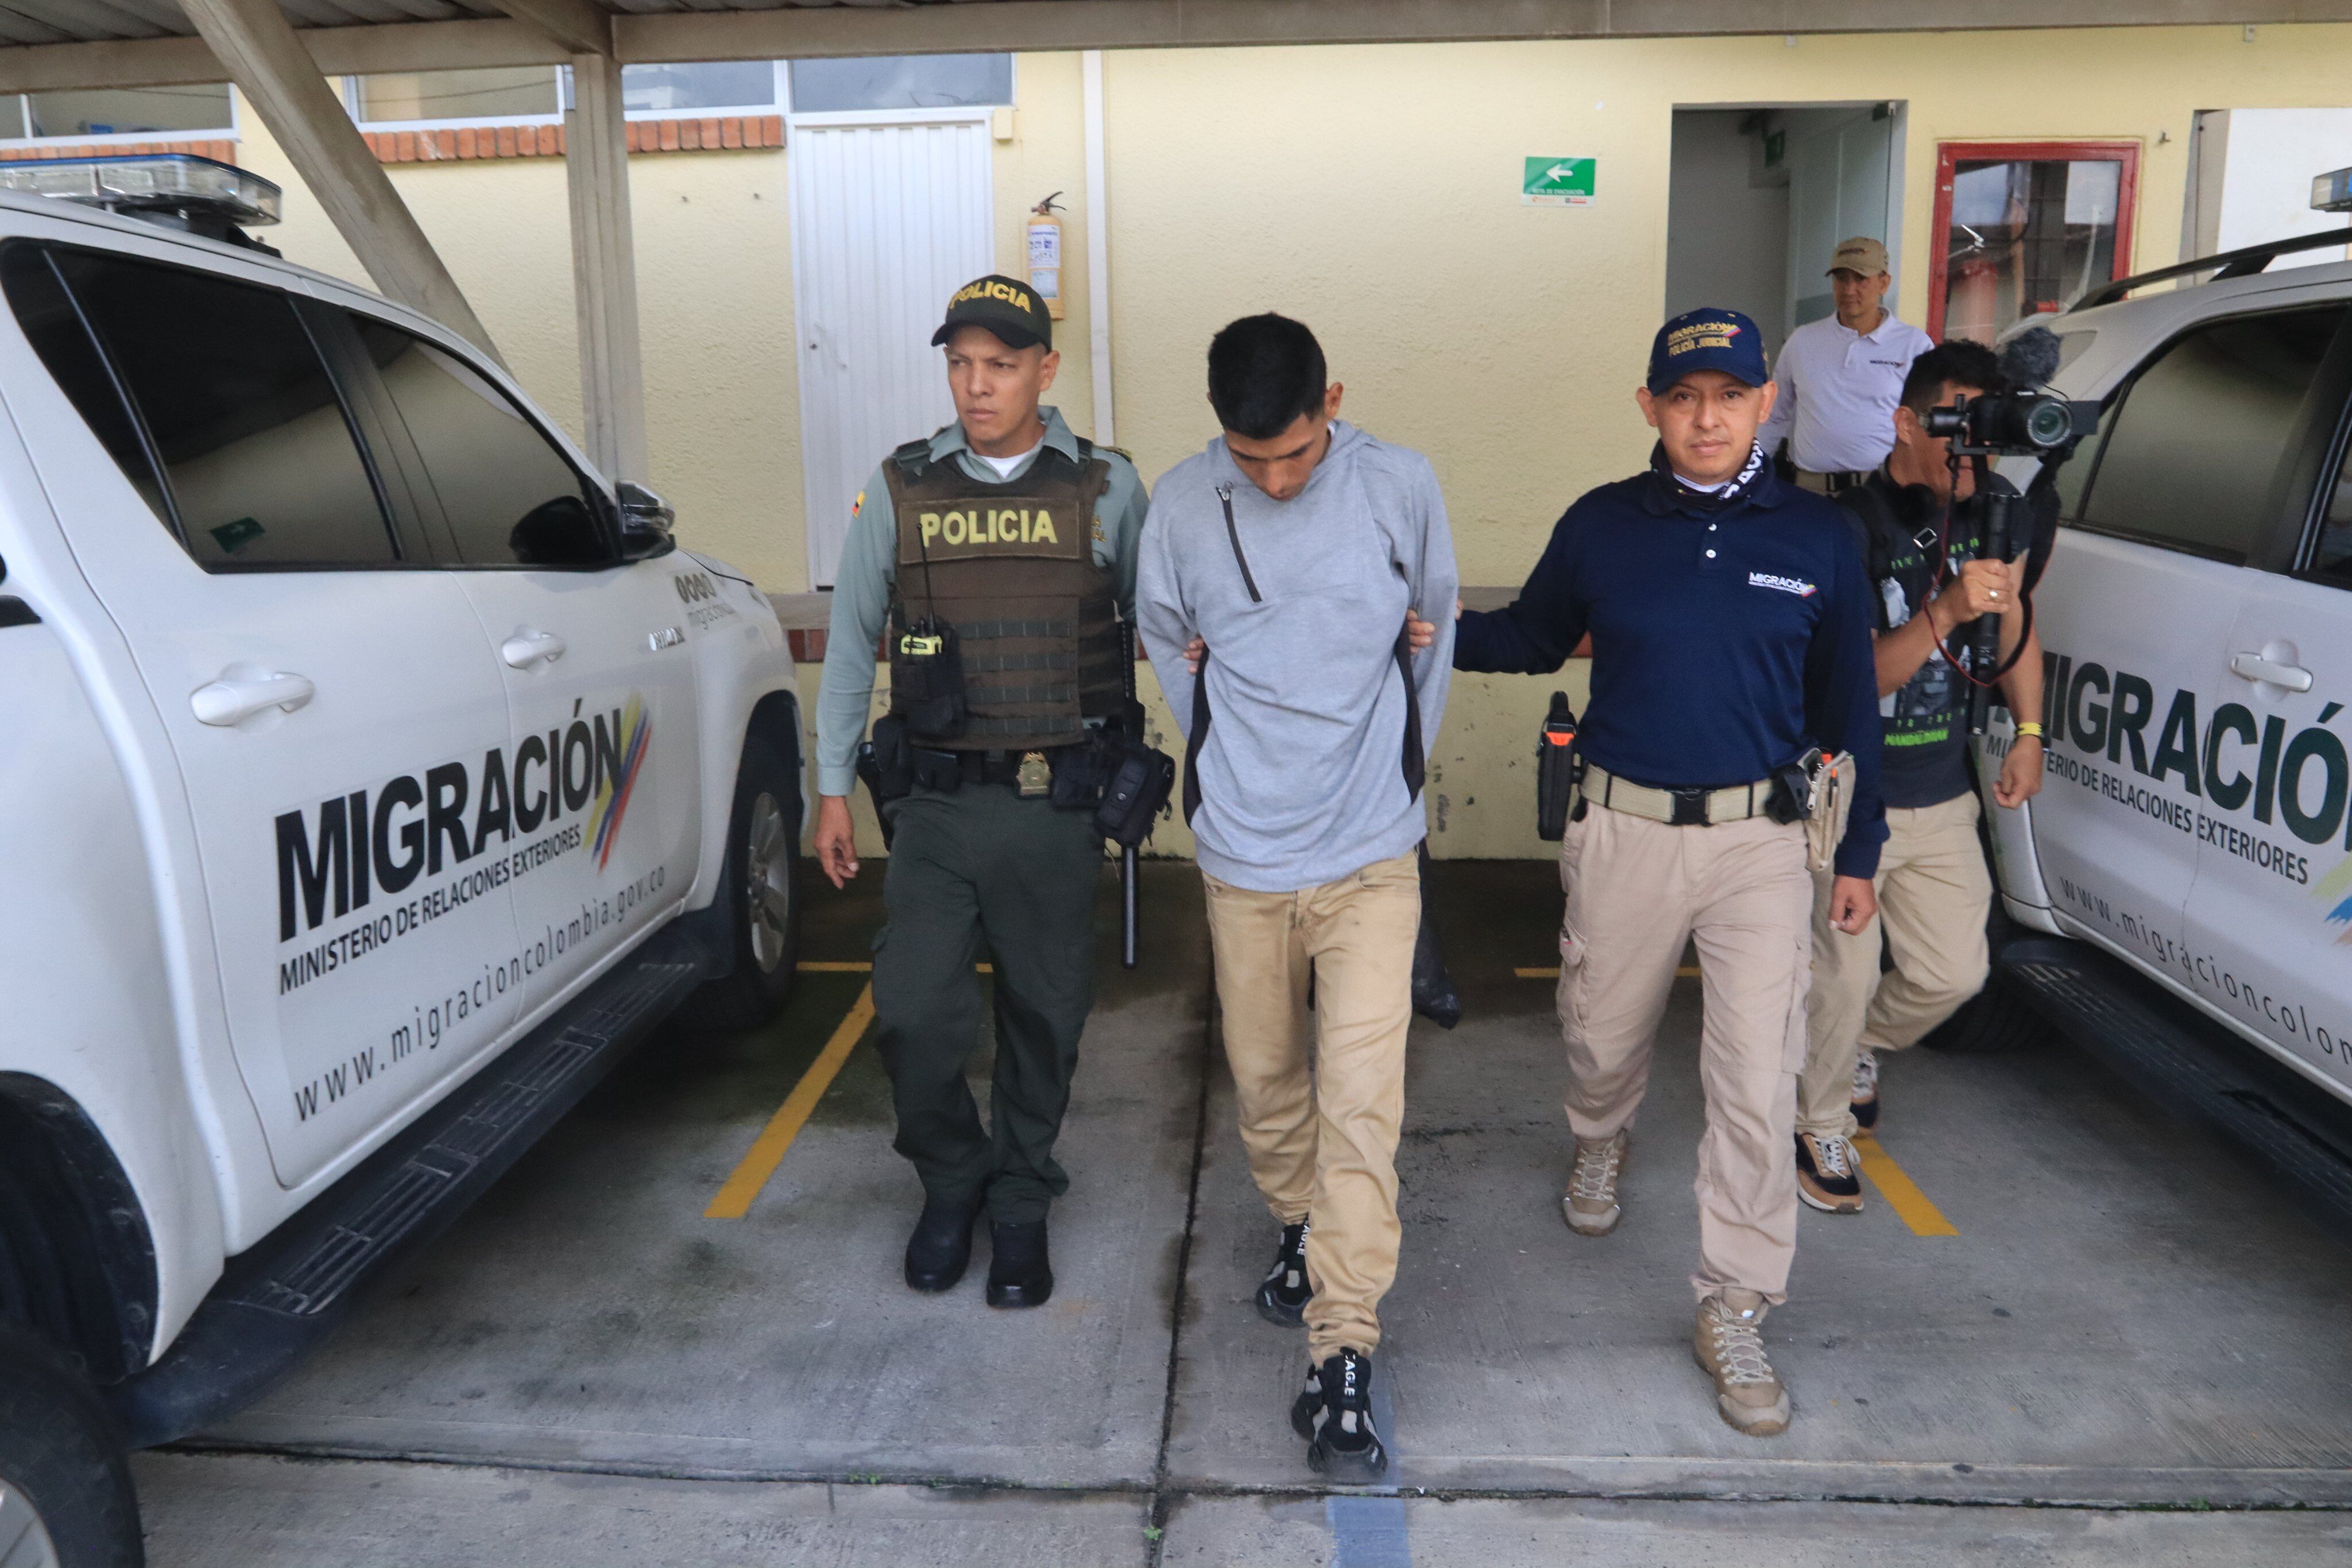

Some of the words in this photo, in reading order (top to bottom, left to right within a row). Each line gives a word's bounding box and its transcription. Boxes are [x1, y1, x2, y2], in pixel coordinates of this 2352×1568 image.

[949, 280, 1031, 313] POLICIA
[920, 509, 1058, 548] POLICIA
[1749, 571, 1808, 591] MIGRACIÓN
[274, 697, 621, 943] MIGRACIÓN
[1995, 649, 2352, 852] IGRACIÓ
[2082, 764, 2098, 792] DE
[2102, 773, 2191, 833] RELACIONES
[2197, 813, 2308, 885] EXTERIORES
[280, 914, 392, 996] MINISTERIO
[396, 901, 419, 936] DE
[422, 857, 510, 924] RELACIONES
[513, 823, 581, 878] EXTERIORES
[294, 866, 665, 1121] www.migracioncolombia.gov.co
